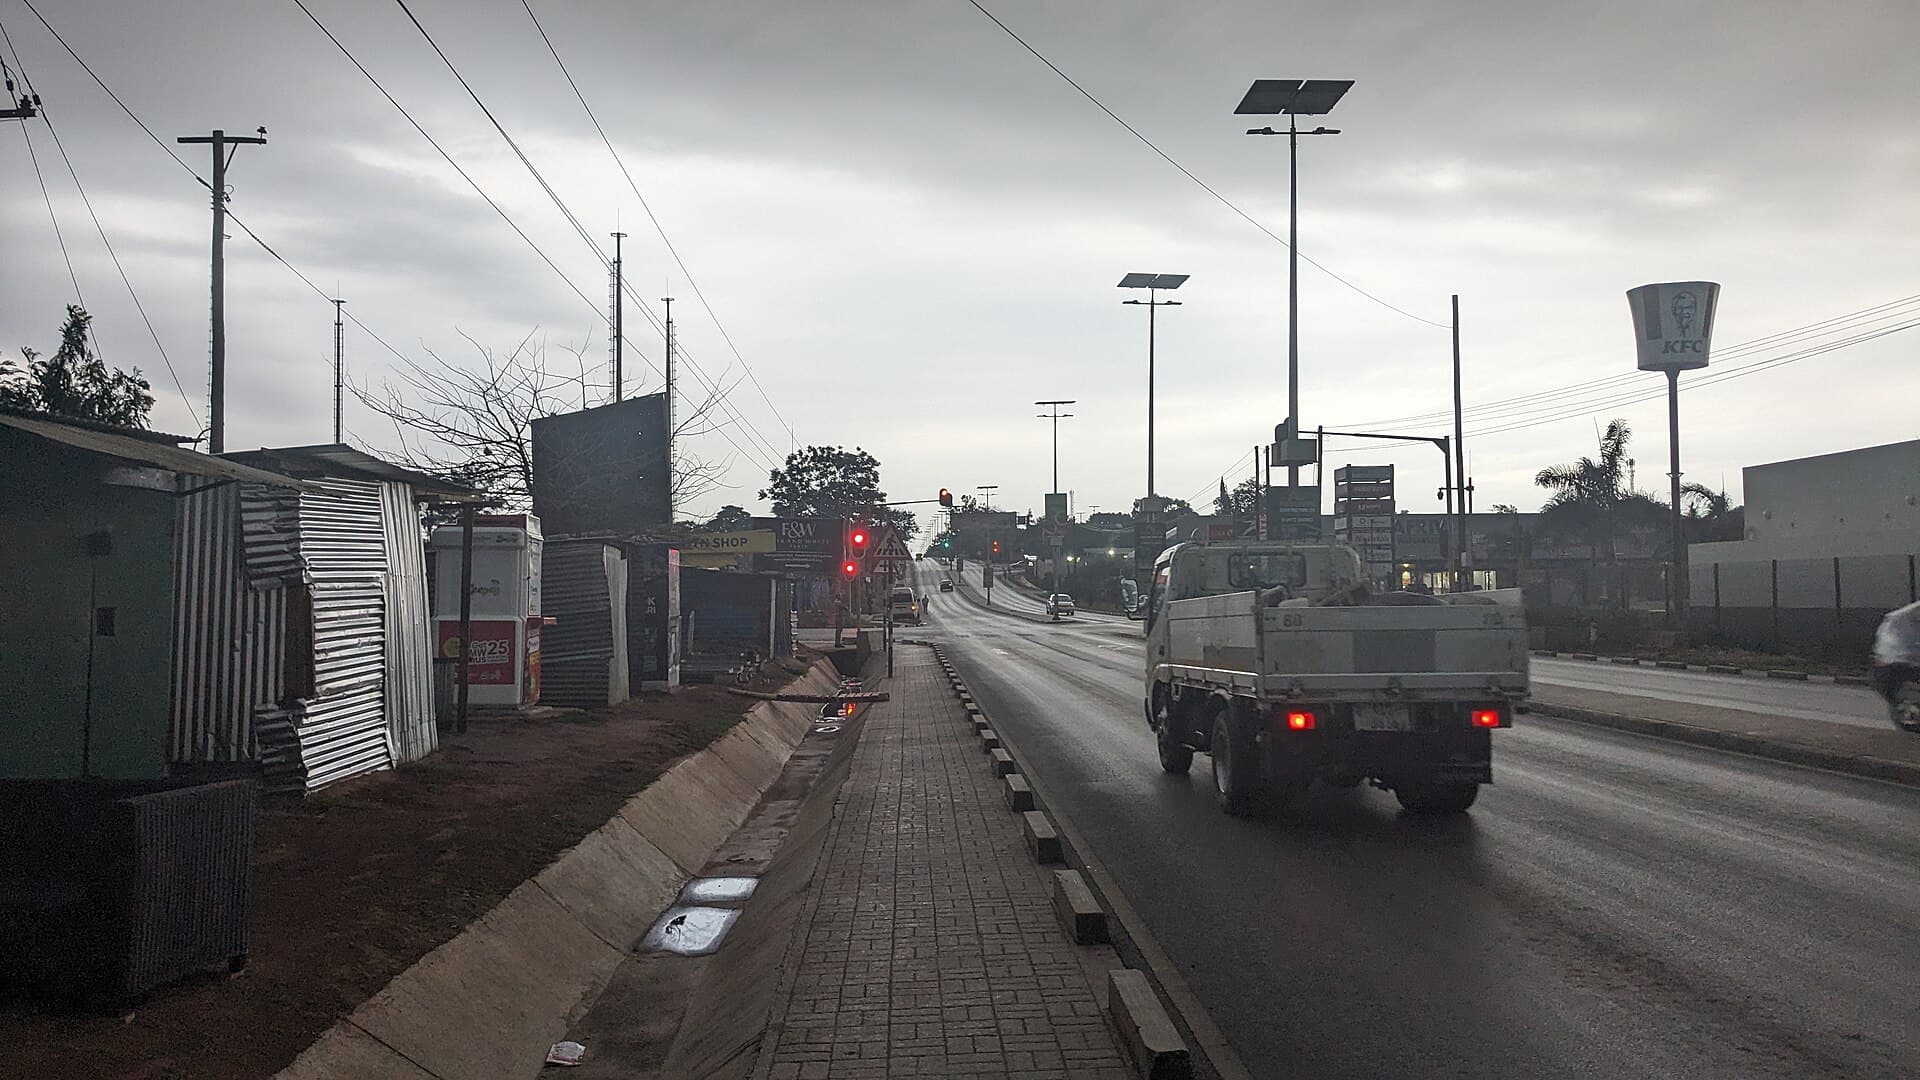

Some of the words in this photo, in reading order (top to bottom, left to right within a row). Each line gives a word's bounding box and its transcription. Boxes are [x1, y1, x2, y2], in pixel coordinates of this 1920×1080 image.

[1661, 340, 1703, 354] KFC
[781, 520, 817, 538] F&W
[712, 537, 748, 548] SHOP
[488, 641, 508, 655] 25
